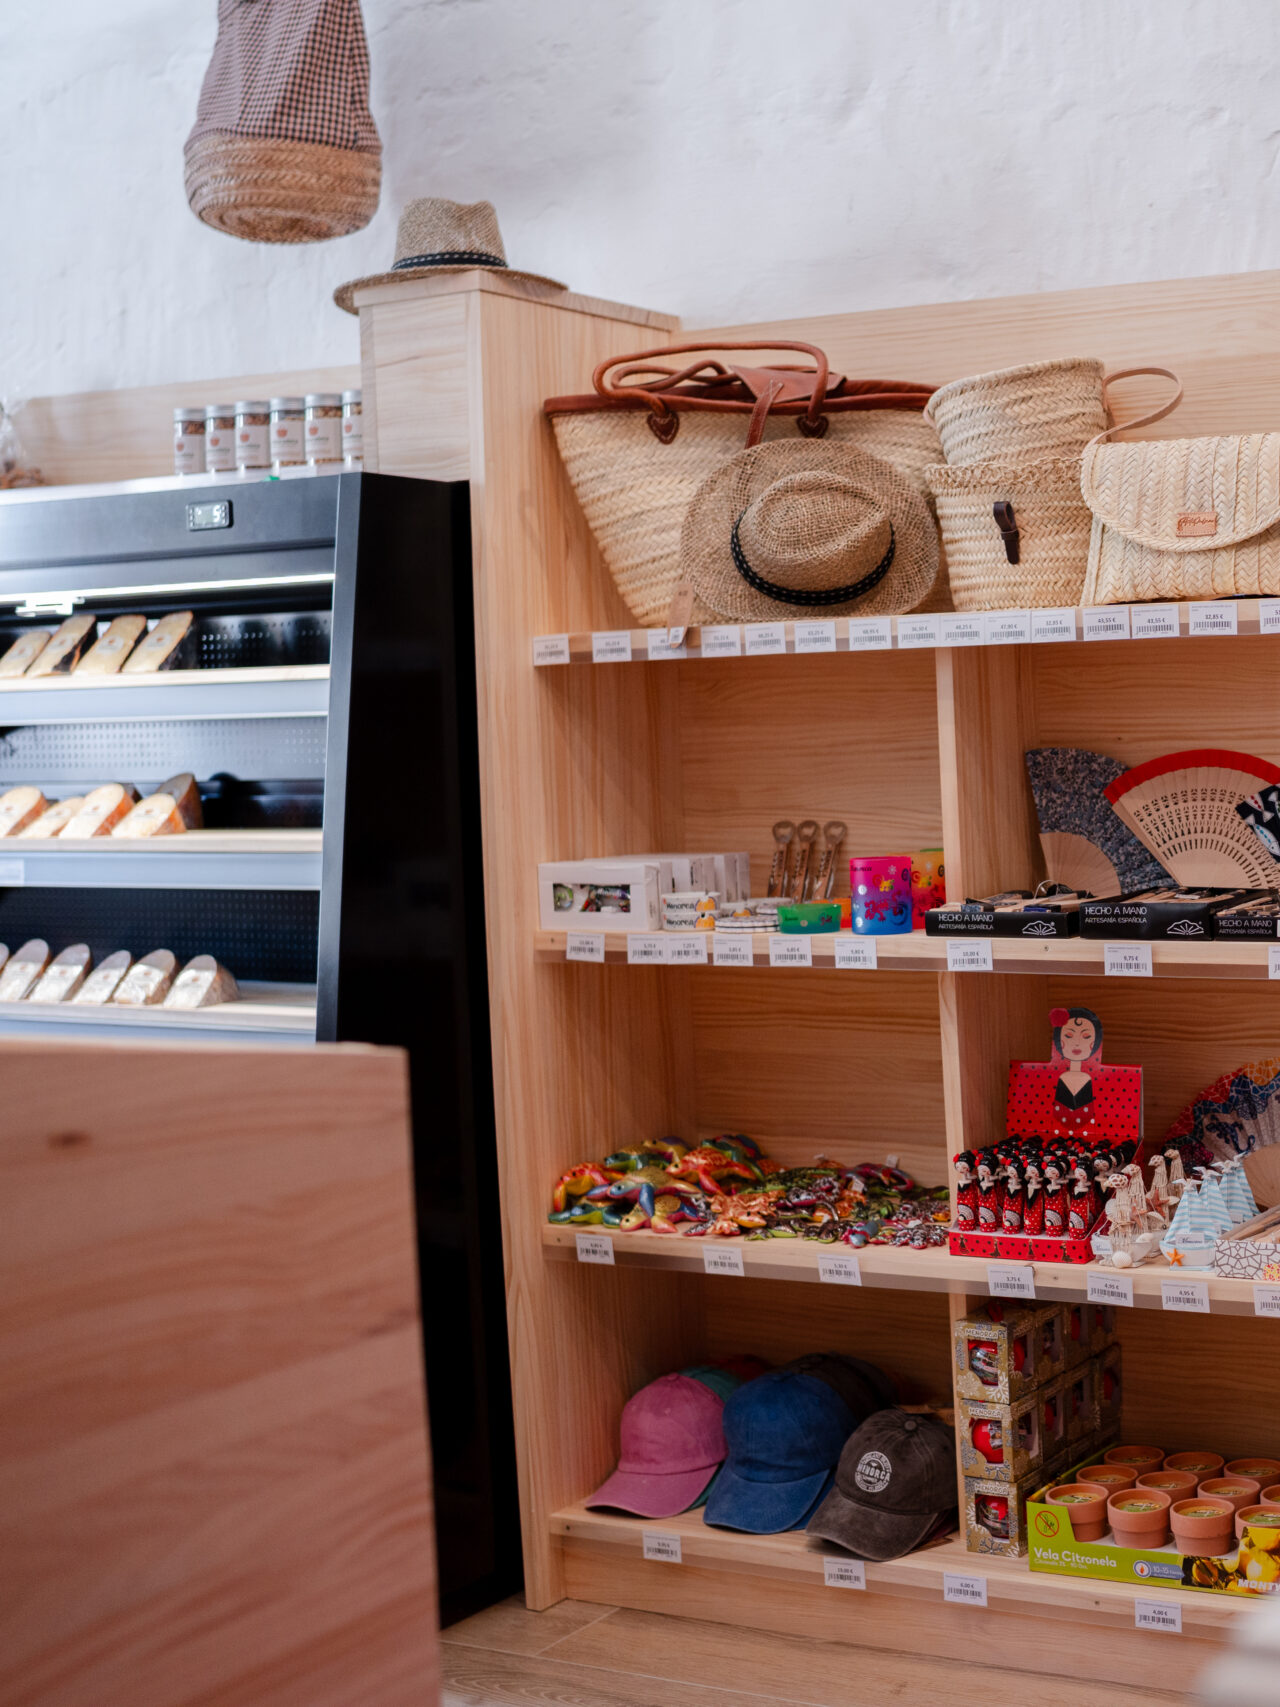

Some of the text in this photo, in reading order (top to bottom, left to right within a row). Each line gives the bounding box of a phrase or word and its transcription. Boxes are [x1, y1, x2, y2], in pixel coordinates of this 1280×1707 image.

[1085, 906, 1148, 916] HECHO A MANO
[938, 913, 994, 922] HECHO A MANO
[1218, 919, 1272, 928] HECHO A MANO
[966, 1328, 998, 1338] MENORCA
[1034, 1546, 1060, 1561] Vela
[1061, 1550, 1118, 1568] Citronela
